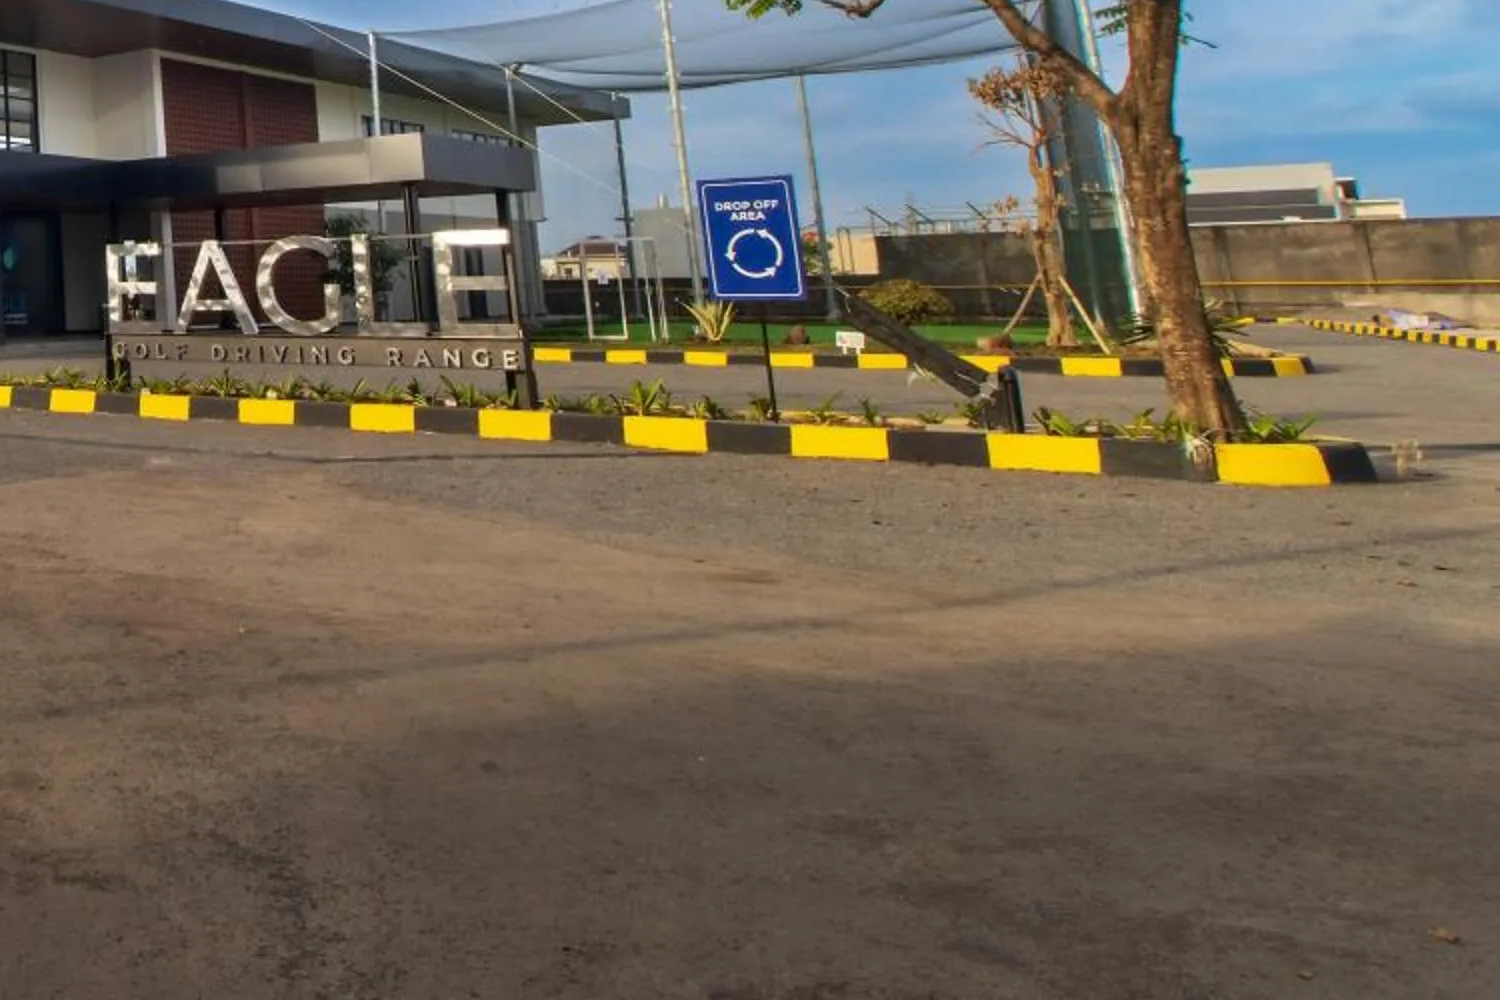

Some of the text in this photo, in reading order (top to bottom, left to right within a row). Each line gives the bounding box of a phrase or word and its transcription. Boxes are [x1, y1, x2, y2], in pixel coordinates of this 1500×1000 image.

[714, 199, 779, 212] DROP OFF
[730, 211, 766, 221] AREA
[106, 229, 521, 337] EAGLE
[112, 341, 519, 370] GOLF DRIVING RANGE
